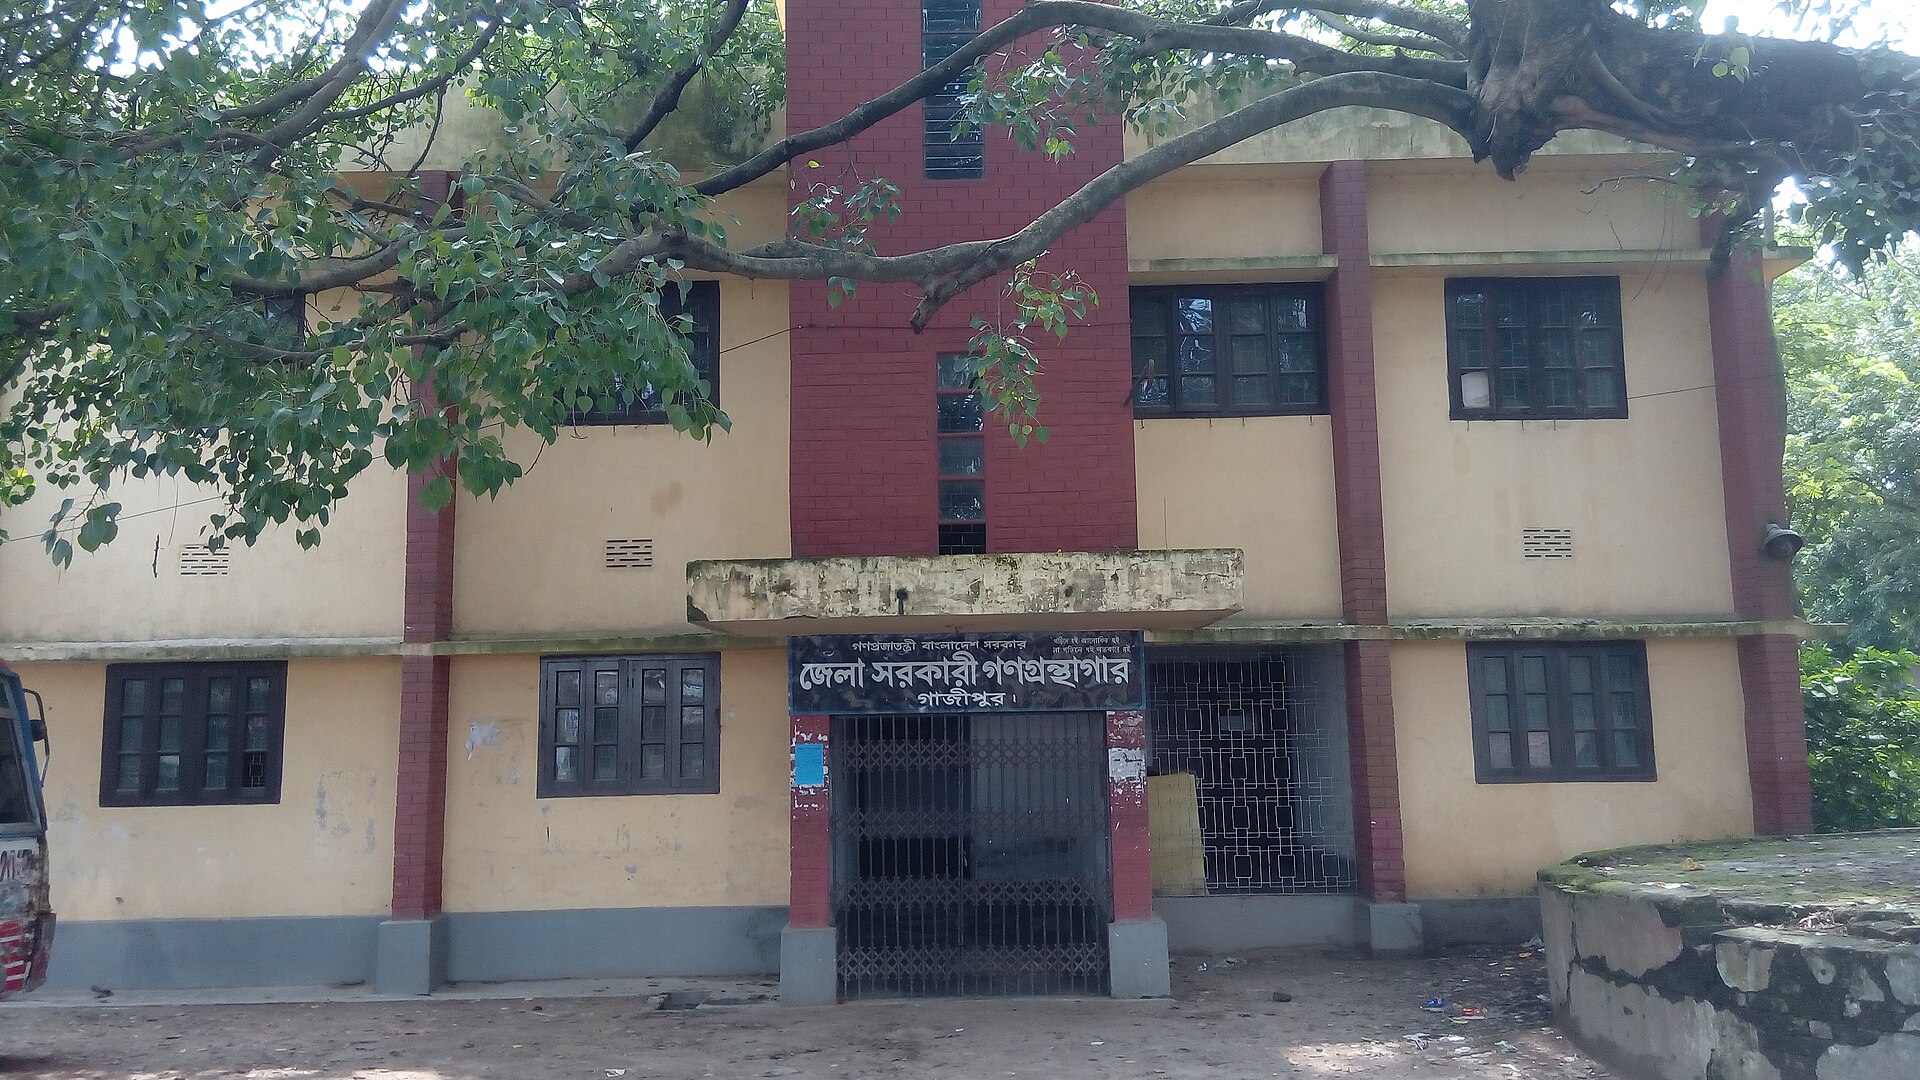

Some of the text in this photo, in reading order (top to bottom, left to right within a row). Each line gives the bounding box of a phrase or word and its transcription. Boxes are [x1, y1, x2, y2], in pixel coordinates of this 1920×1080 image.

[852, 638, 1027, 652] গণপ্রজাতন্ত্রী বাংলাদেশ সরকার
[800, 651, 1132, 690] জেলা সরকারী গণগ্রন্থাগার
